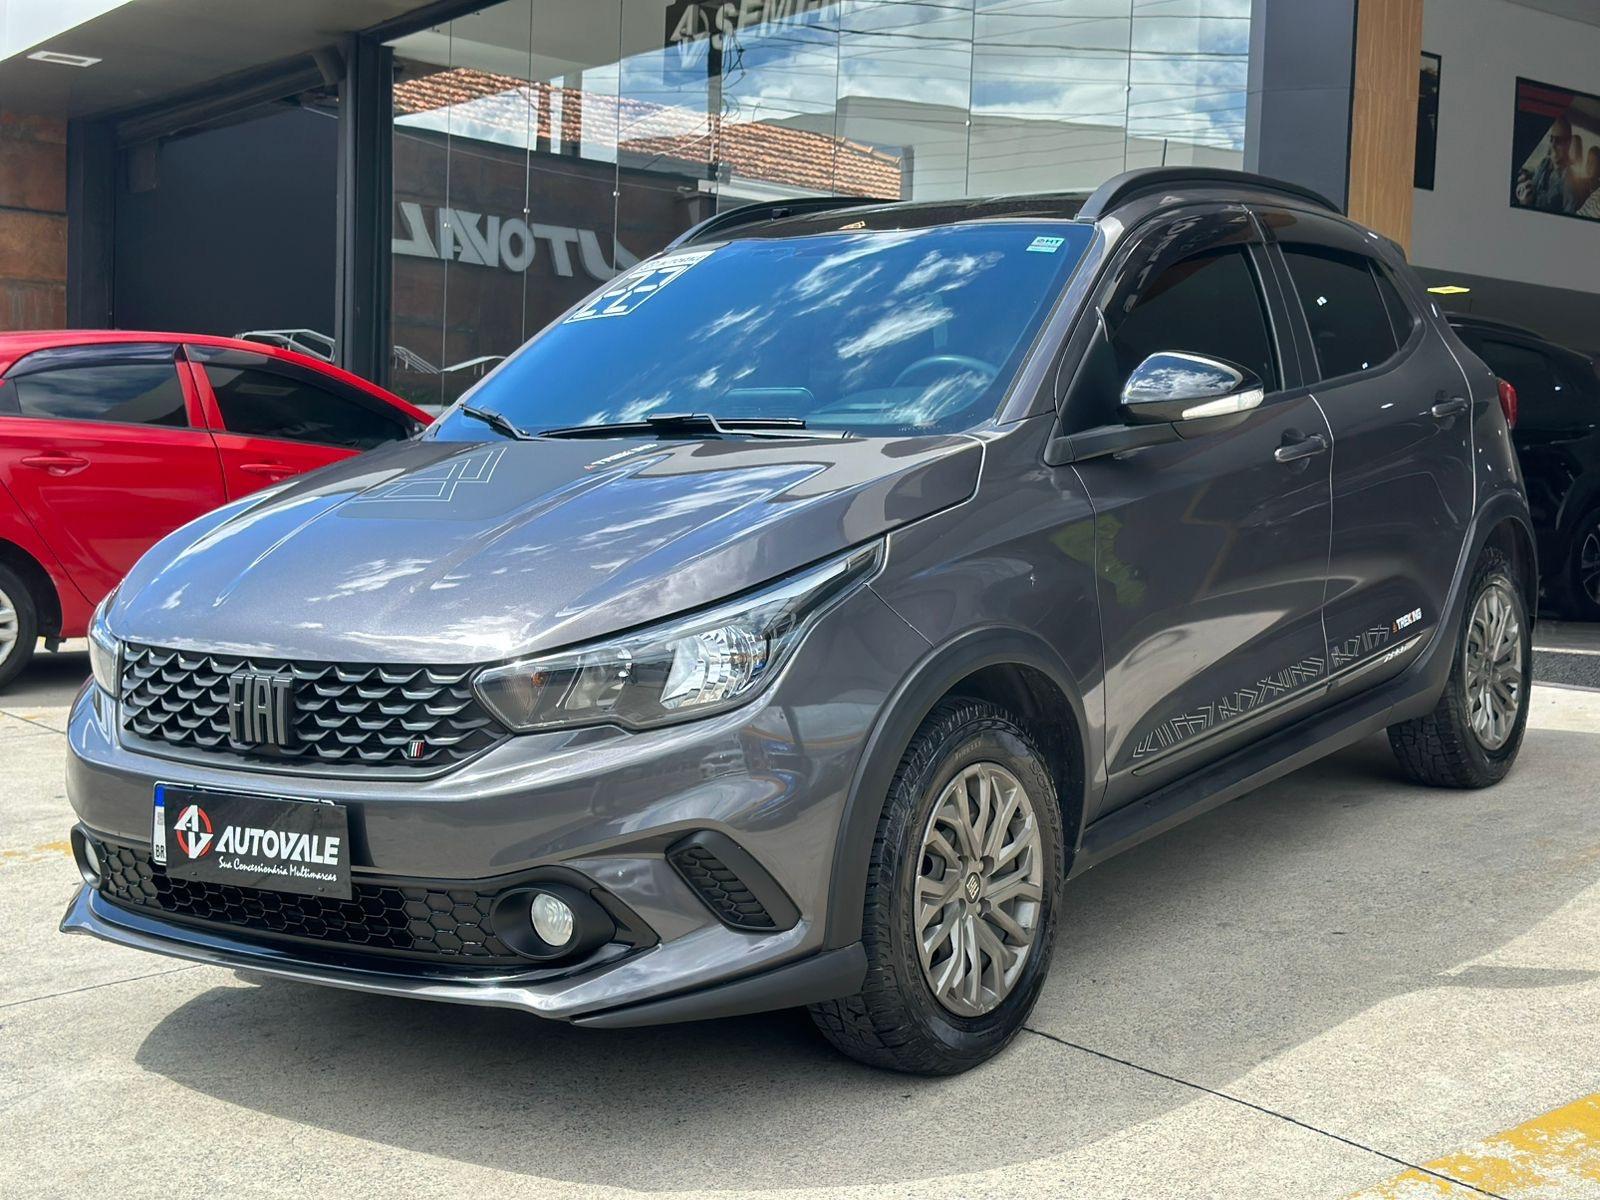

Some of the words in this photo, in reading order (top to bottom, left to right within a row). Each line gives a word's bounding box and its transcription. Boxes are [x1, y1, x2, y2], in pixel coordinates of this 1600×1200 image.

[228, 674, 293, 745] FIAT
[155, 844, 166, 858] BR
[214, 825, 340, 866] AUTOVALE
[218, 855, 232, 869] Sua
[289, 864, 337, 882] Multimarcas
